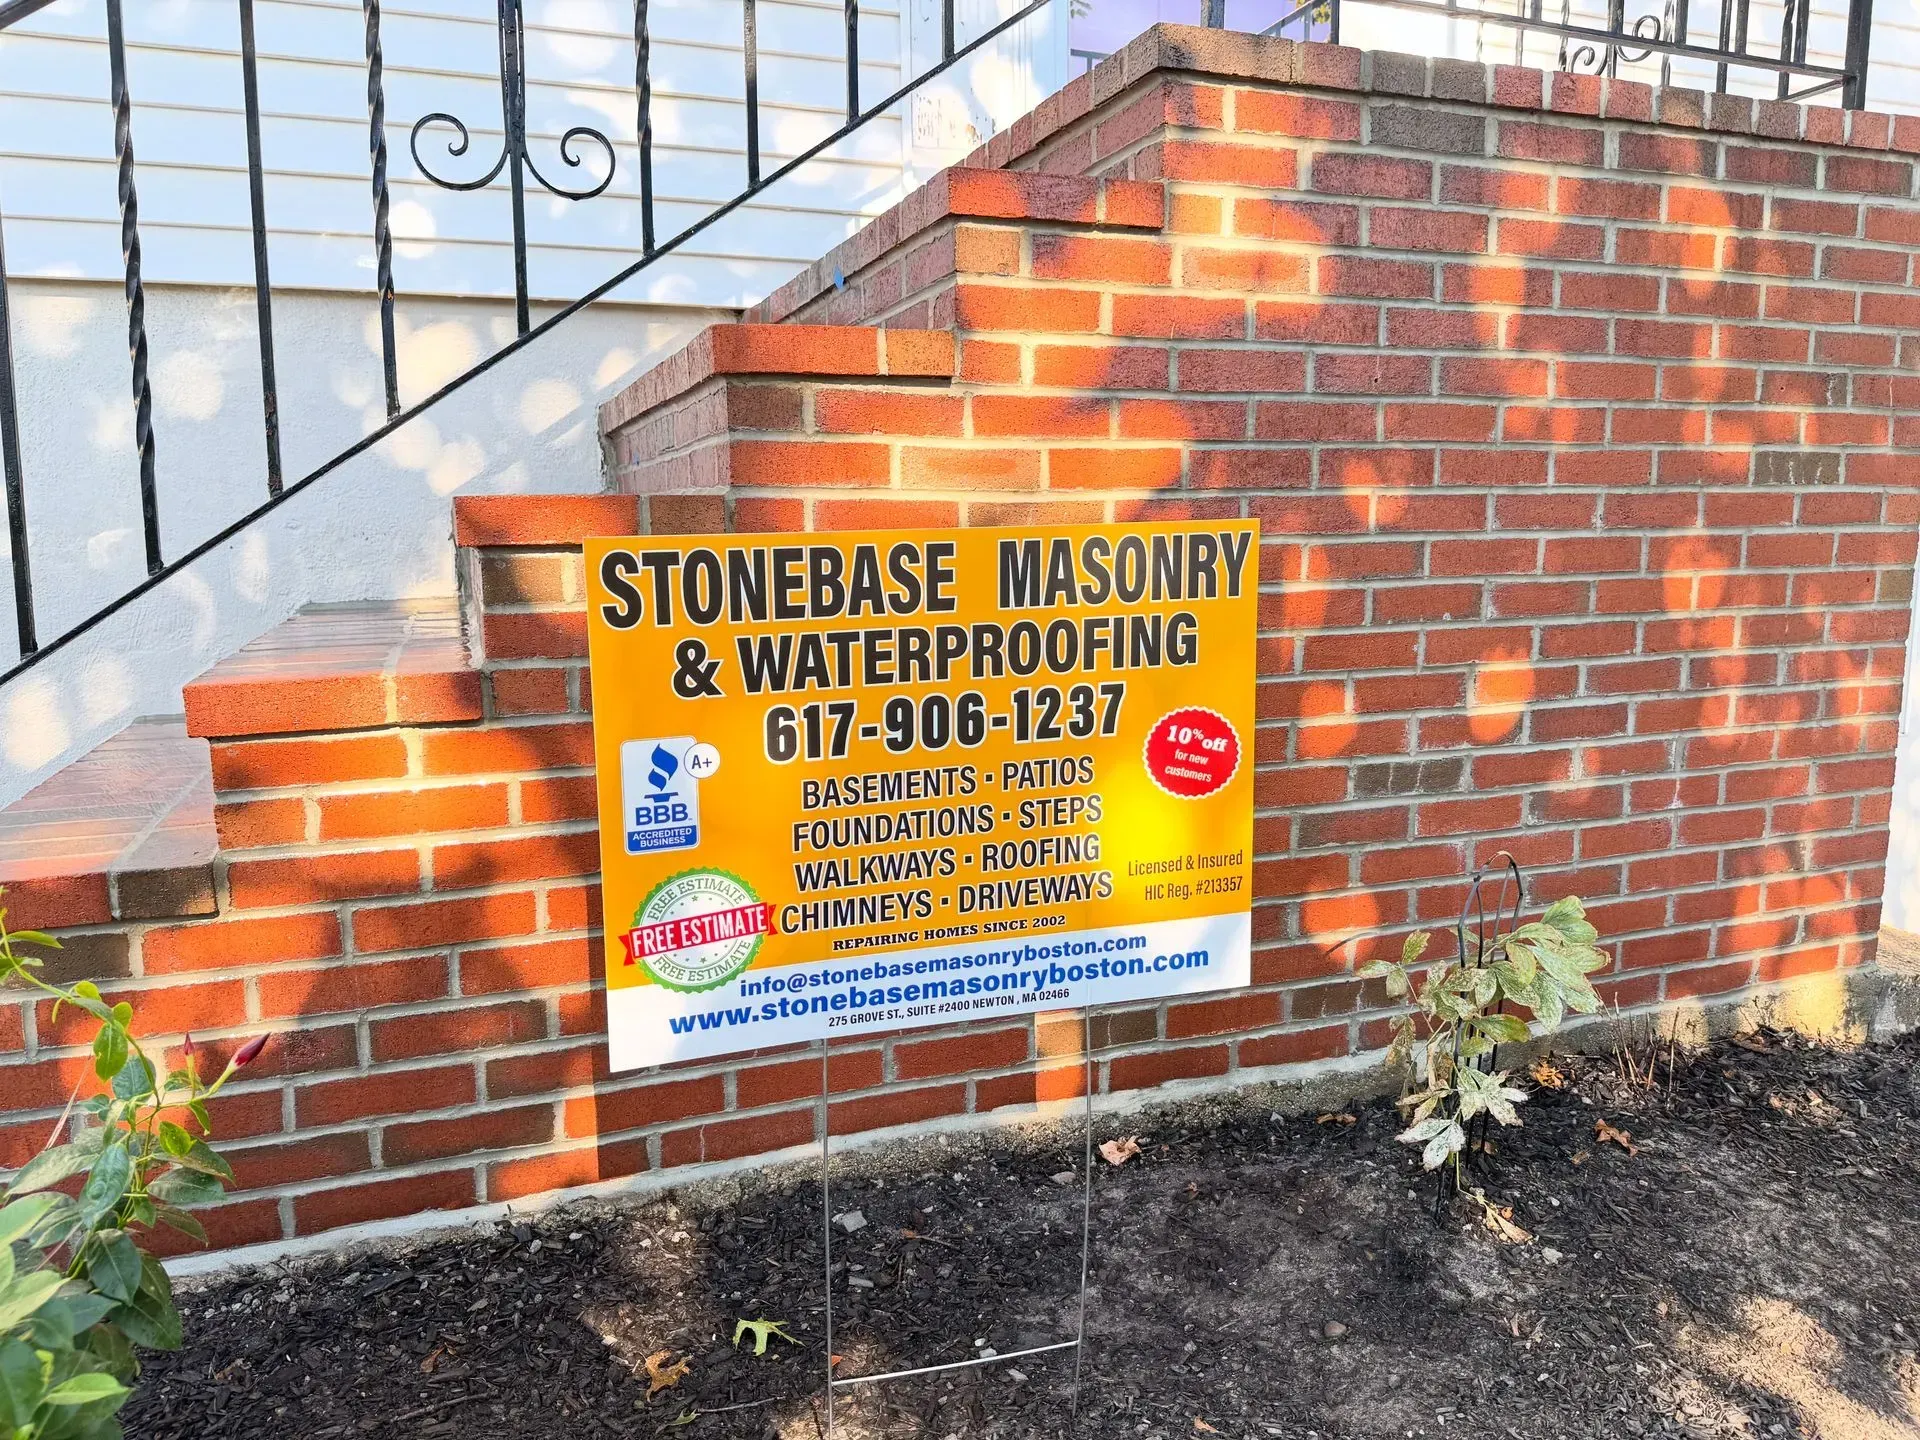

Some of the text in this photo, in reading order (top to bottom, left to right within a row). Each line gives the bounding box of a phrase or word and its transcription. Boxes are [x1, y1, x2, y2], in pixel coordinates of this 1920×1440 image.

[600, 531, 1253, 630] STONEBASE MASONRY
[671, 612, 1198, 699] & WATERPROOFING
[764, 681, 1126, 764] 617-906-1237
[691, 754, 712, 770] A+
[1165, 765, 1212, 782] customers
[1174, 748, 1209, 765] for new
[802, 755, 1095, 811] BASEMENTS PATIOS
[632, 828, 692, 841] ACCREDITED
[635, 803, 689, 826] BBB
[792, 793, 1102, 852] FOUNDATIONS STEPS
[640, 836, 686, 848] BUSINESS
[794, 833, 1101, 892] WALKWAYS ROOFING
[1128, 850, 1243, 876] Licensed & Insured
[648, 877, 746, 921] FREE ESTIMATE
[781, 870, 1113, 934] CHIMNEYS DRIVEWAYS
[1145, 876, 1243, 901] HIC Reg. #213357
[631, 906, 768, 957] FREE ESTIMATE
[832, 915, 1066, 951] REPAIRING HOMES SINCE 2002
[653, 939, 752, 982] FREE ESTIMATE
[740, 935, 1147, 997] info@stonebasemasonryboston.com
[669, 950, 1209, 1034] www.stonebasemasonryboston.com
[828, 1016, 848, 1027] 275
[850, 1012, 885, 1025] GROVE
[906, 1005, 937, 1017] SUITE
[938, 1001, 970, 1013] #2400
[1022, 993, 1037, 1004] MA
[1039, 988, 1070, 1001] 02466
